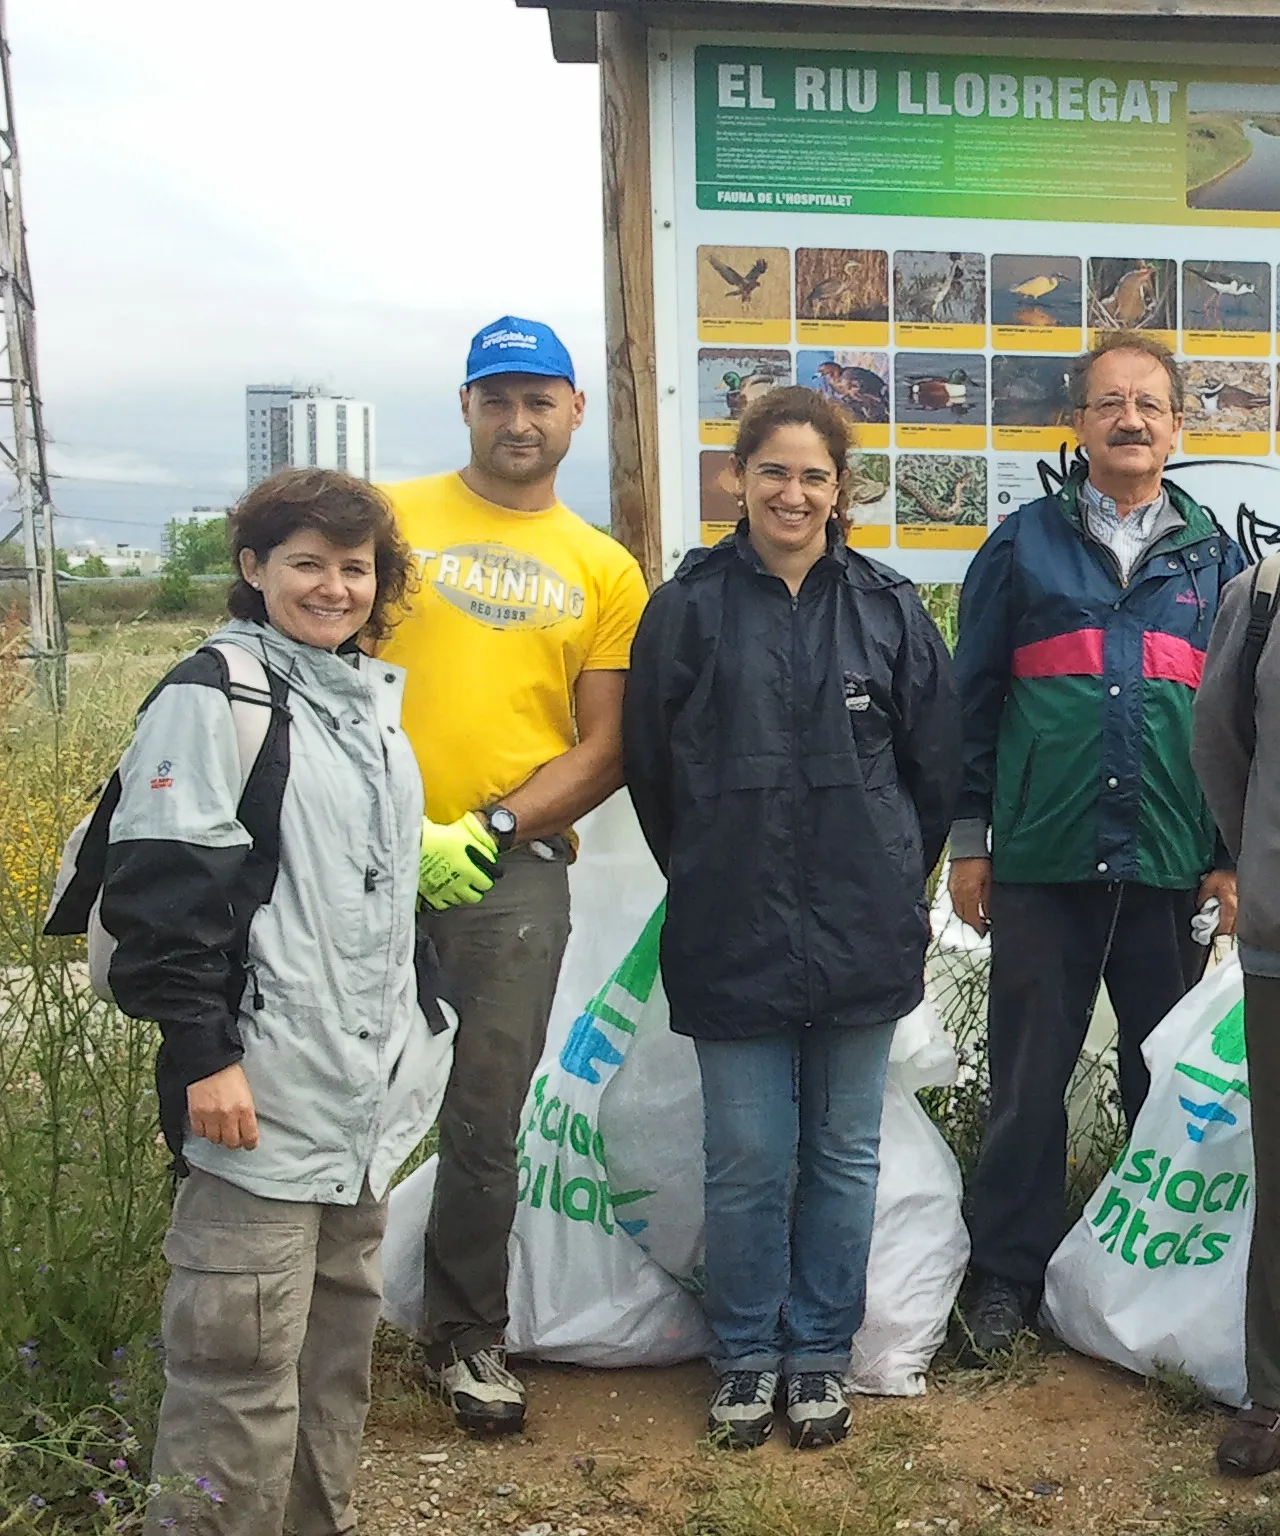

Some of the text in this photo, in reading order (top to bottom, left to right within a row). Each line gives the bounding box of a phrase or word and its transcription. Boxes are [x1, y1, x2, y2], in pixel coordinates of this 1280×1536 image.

[717, 63, 1177, 124] EL RIU LLOBREGAT
[717, 191, 853, 207] FAUNA DE L'HOSPITALET
[411, 548, 585, 619] TRAINING
